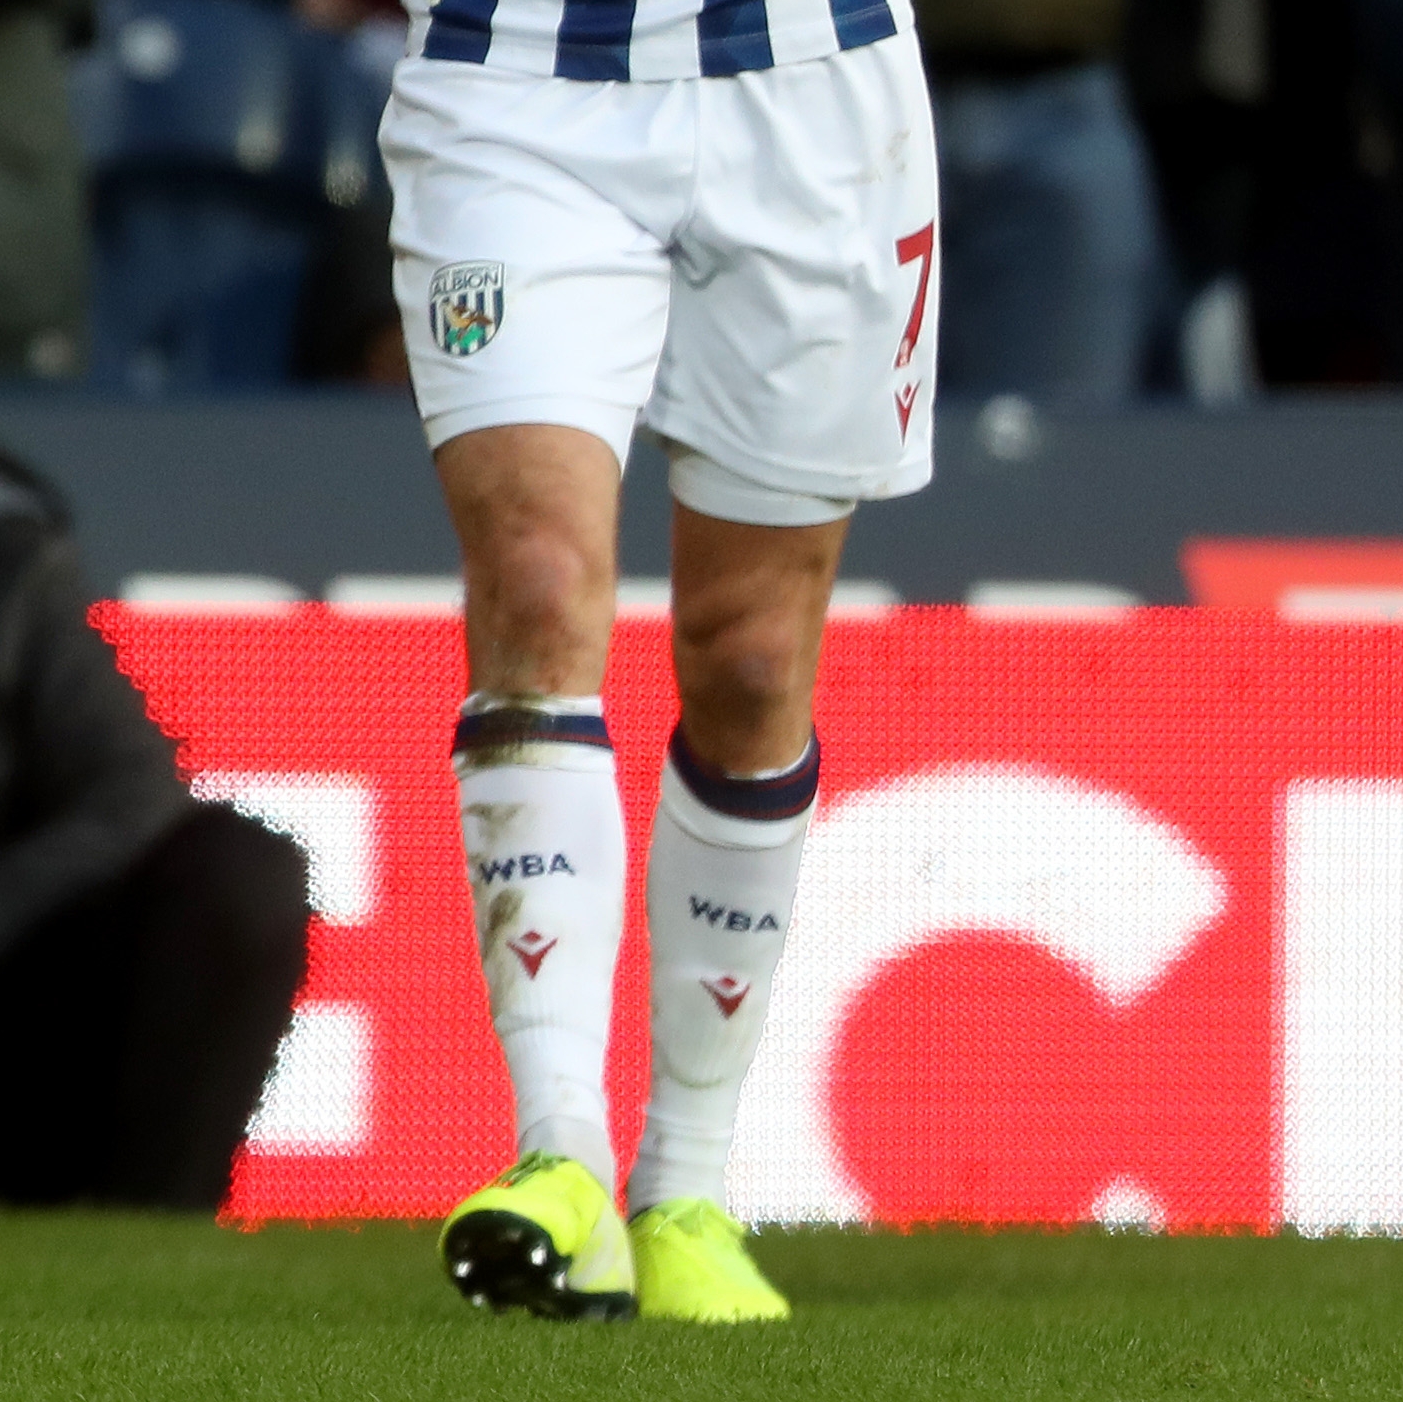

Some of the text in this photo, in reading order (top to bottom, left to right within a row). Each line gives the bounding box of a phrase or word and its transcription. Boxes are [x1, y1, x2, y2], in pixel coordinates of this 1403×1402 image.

[432, 270, 498, 296] ALBION
[894, 219, 934, 371] 7
[480, 853, 576, 885] WBA
[689, 895, 779, 932] WBA
